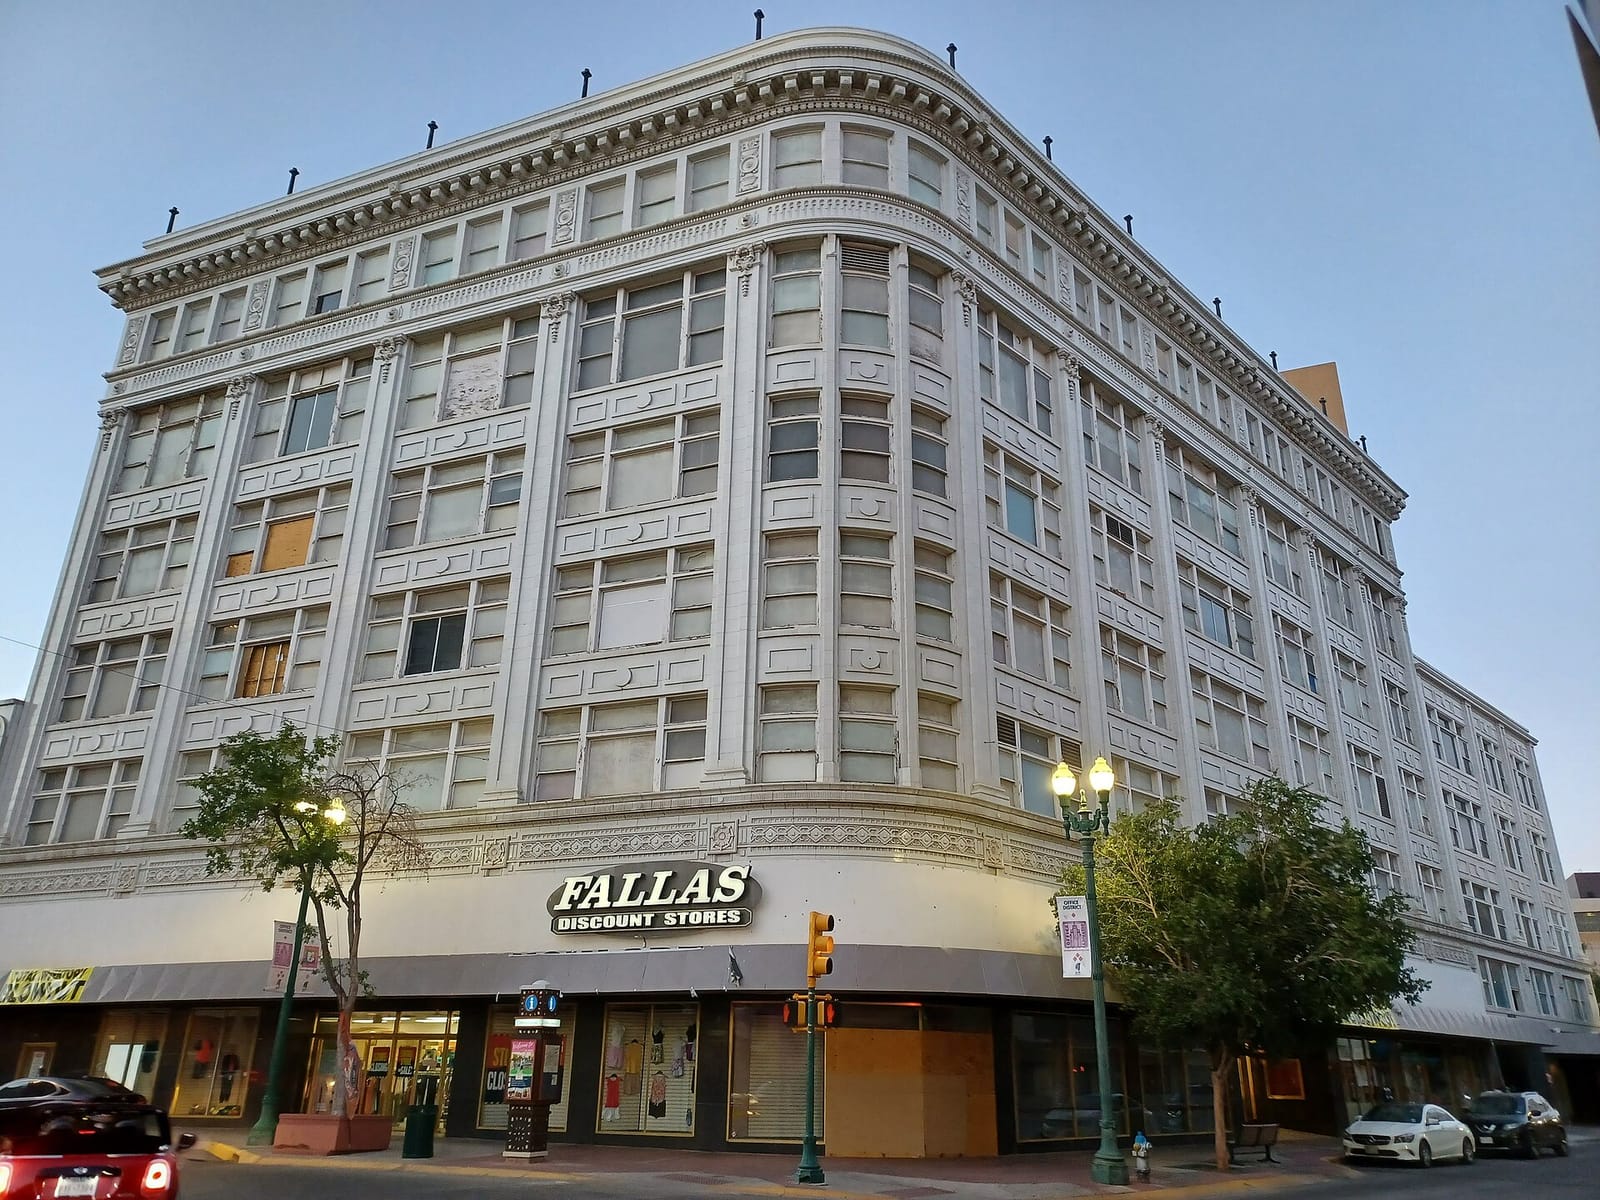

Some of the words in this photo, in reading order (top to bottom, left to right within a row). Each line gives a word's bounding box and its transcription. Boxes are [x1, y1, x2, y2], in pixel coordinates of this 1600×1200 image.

[553, 865, 751, 911] FALLAS
[557, 913, 655, 931] DISCOUNT
[663, 910, 741, 926] STORES
